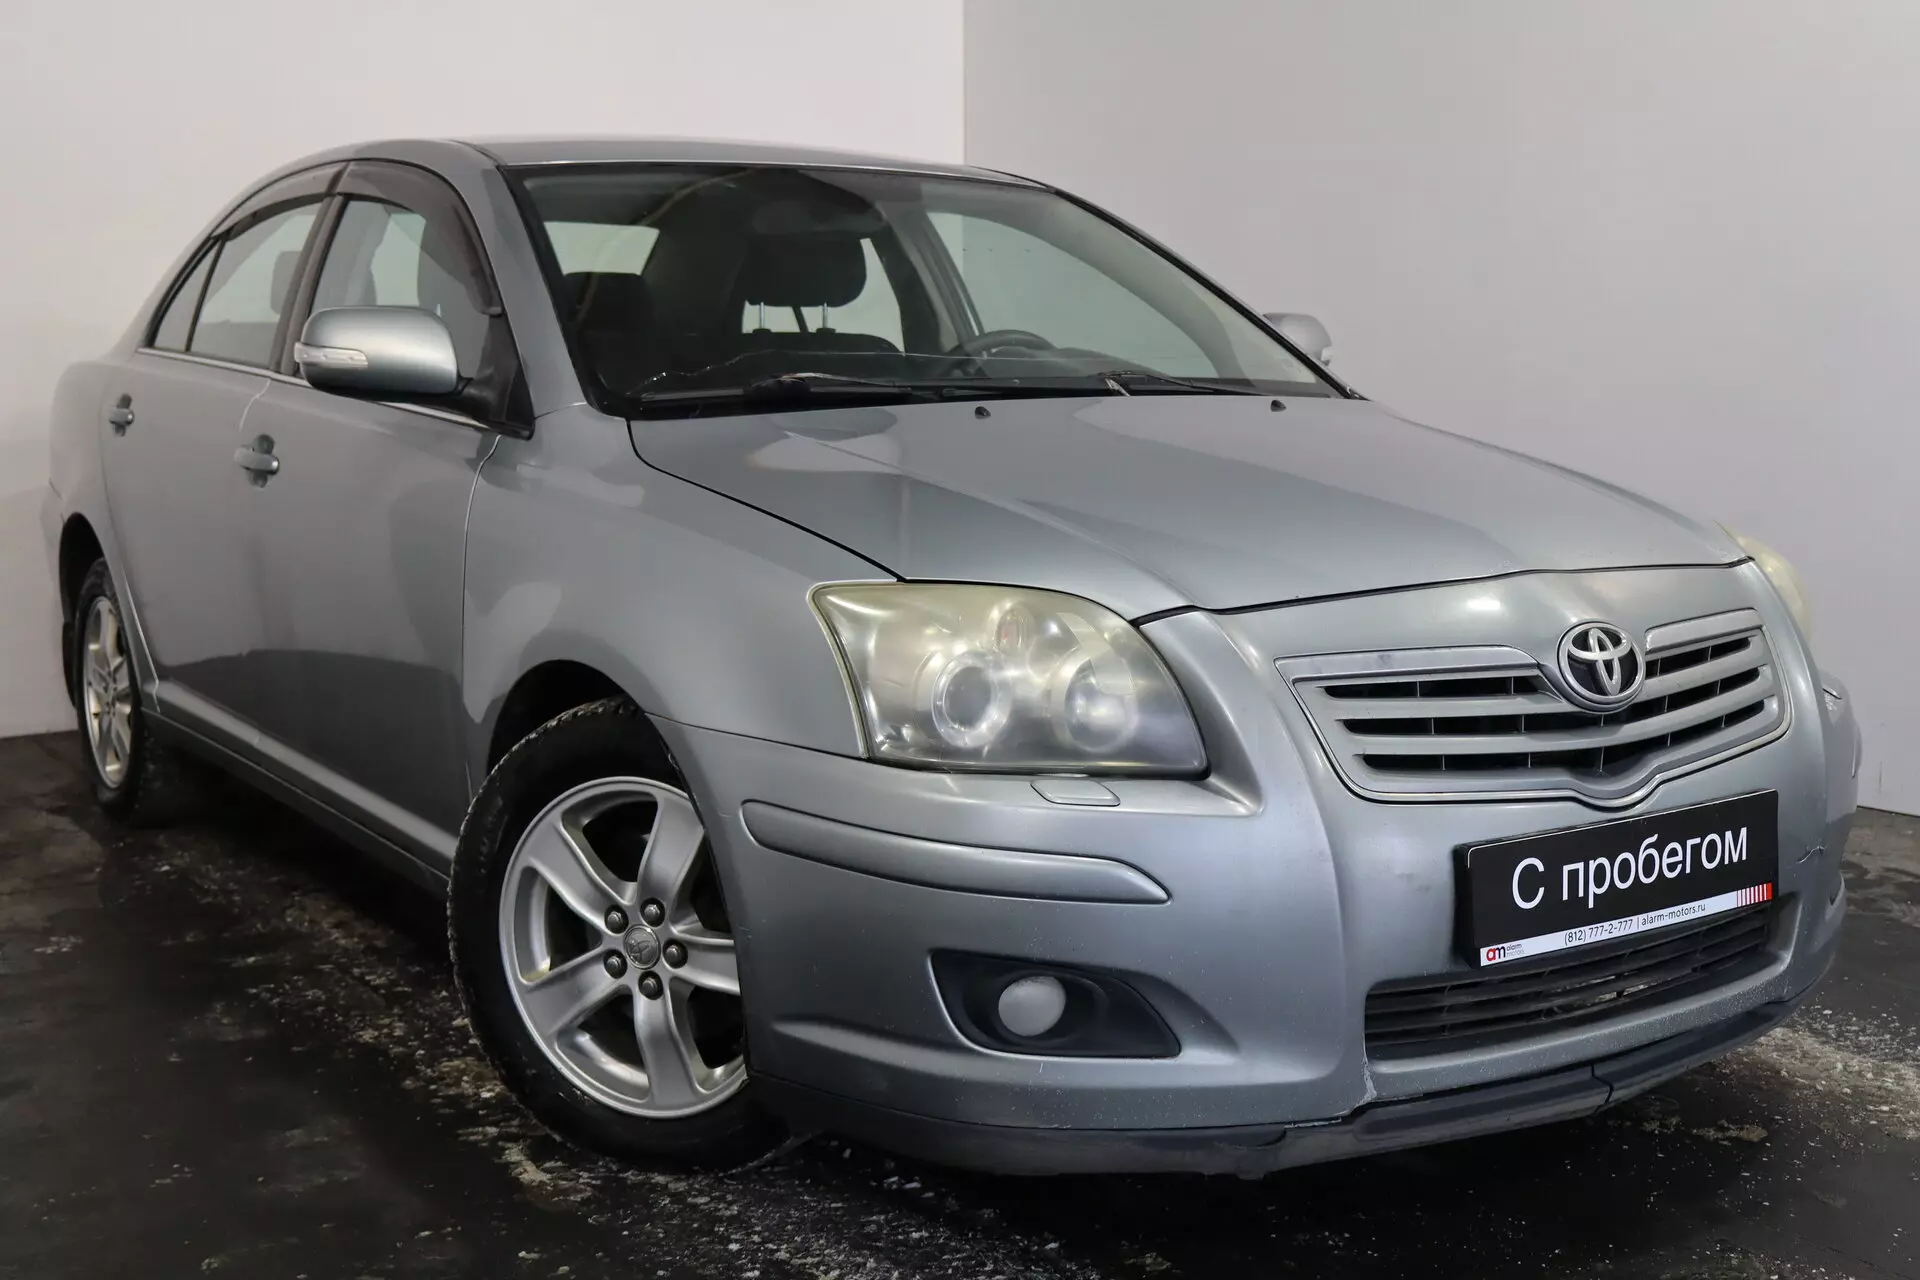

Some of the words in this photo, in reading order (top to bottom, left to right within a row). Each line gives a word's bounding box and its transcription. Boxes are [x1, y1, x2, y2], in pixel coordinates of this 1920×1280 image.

[1512, 857, 1544, 909] С
[1562, 827, 1747, 908] пробегом
[1564, 929, 1586, 945] (812)
[1588, 919, 1633, 938] 777-2-777
[1641, 903, 1706, 926] alarm-motors.ru
